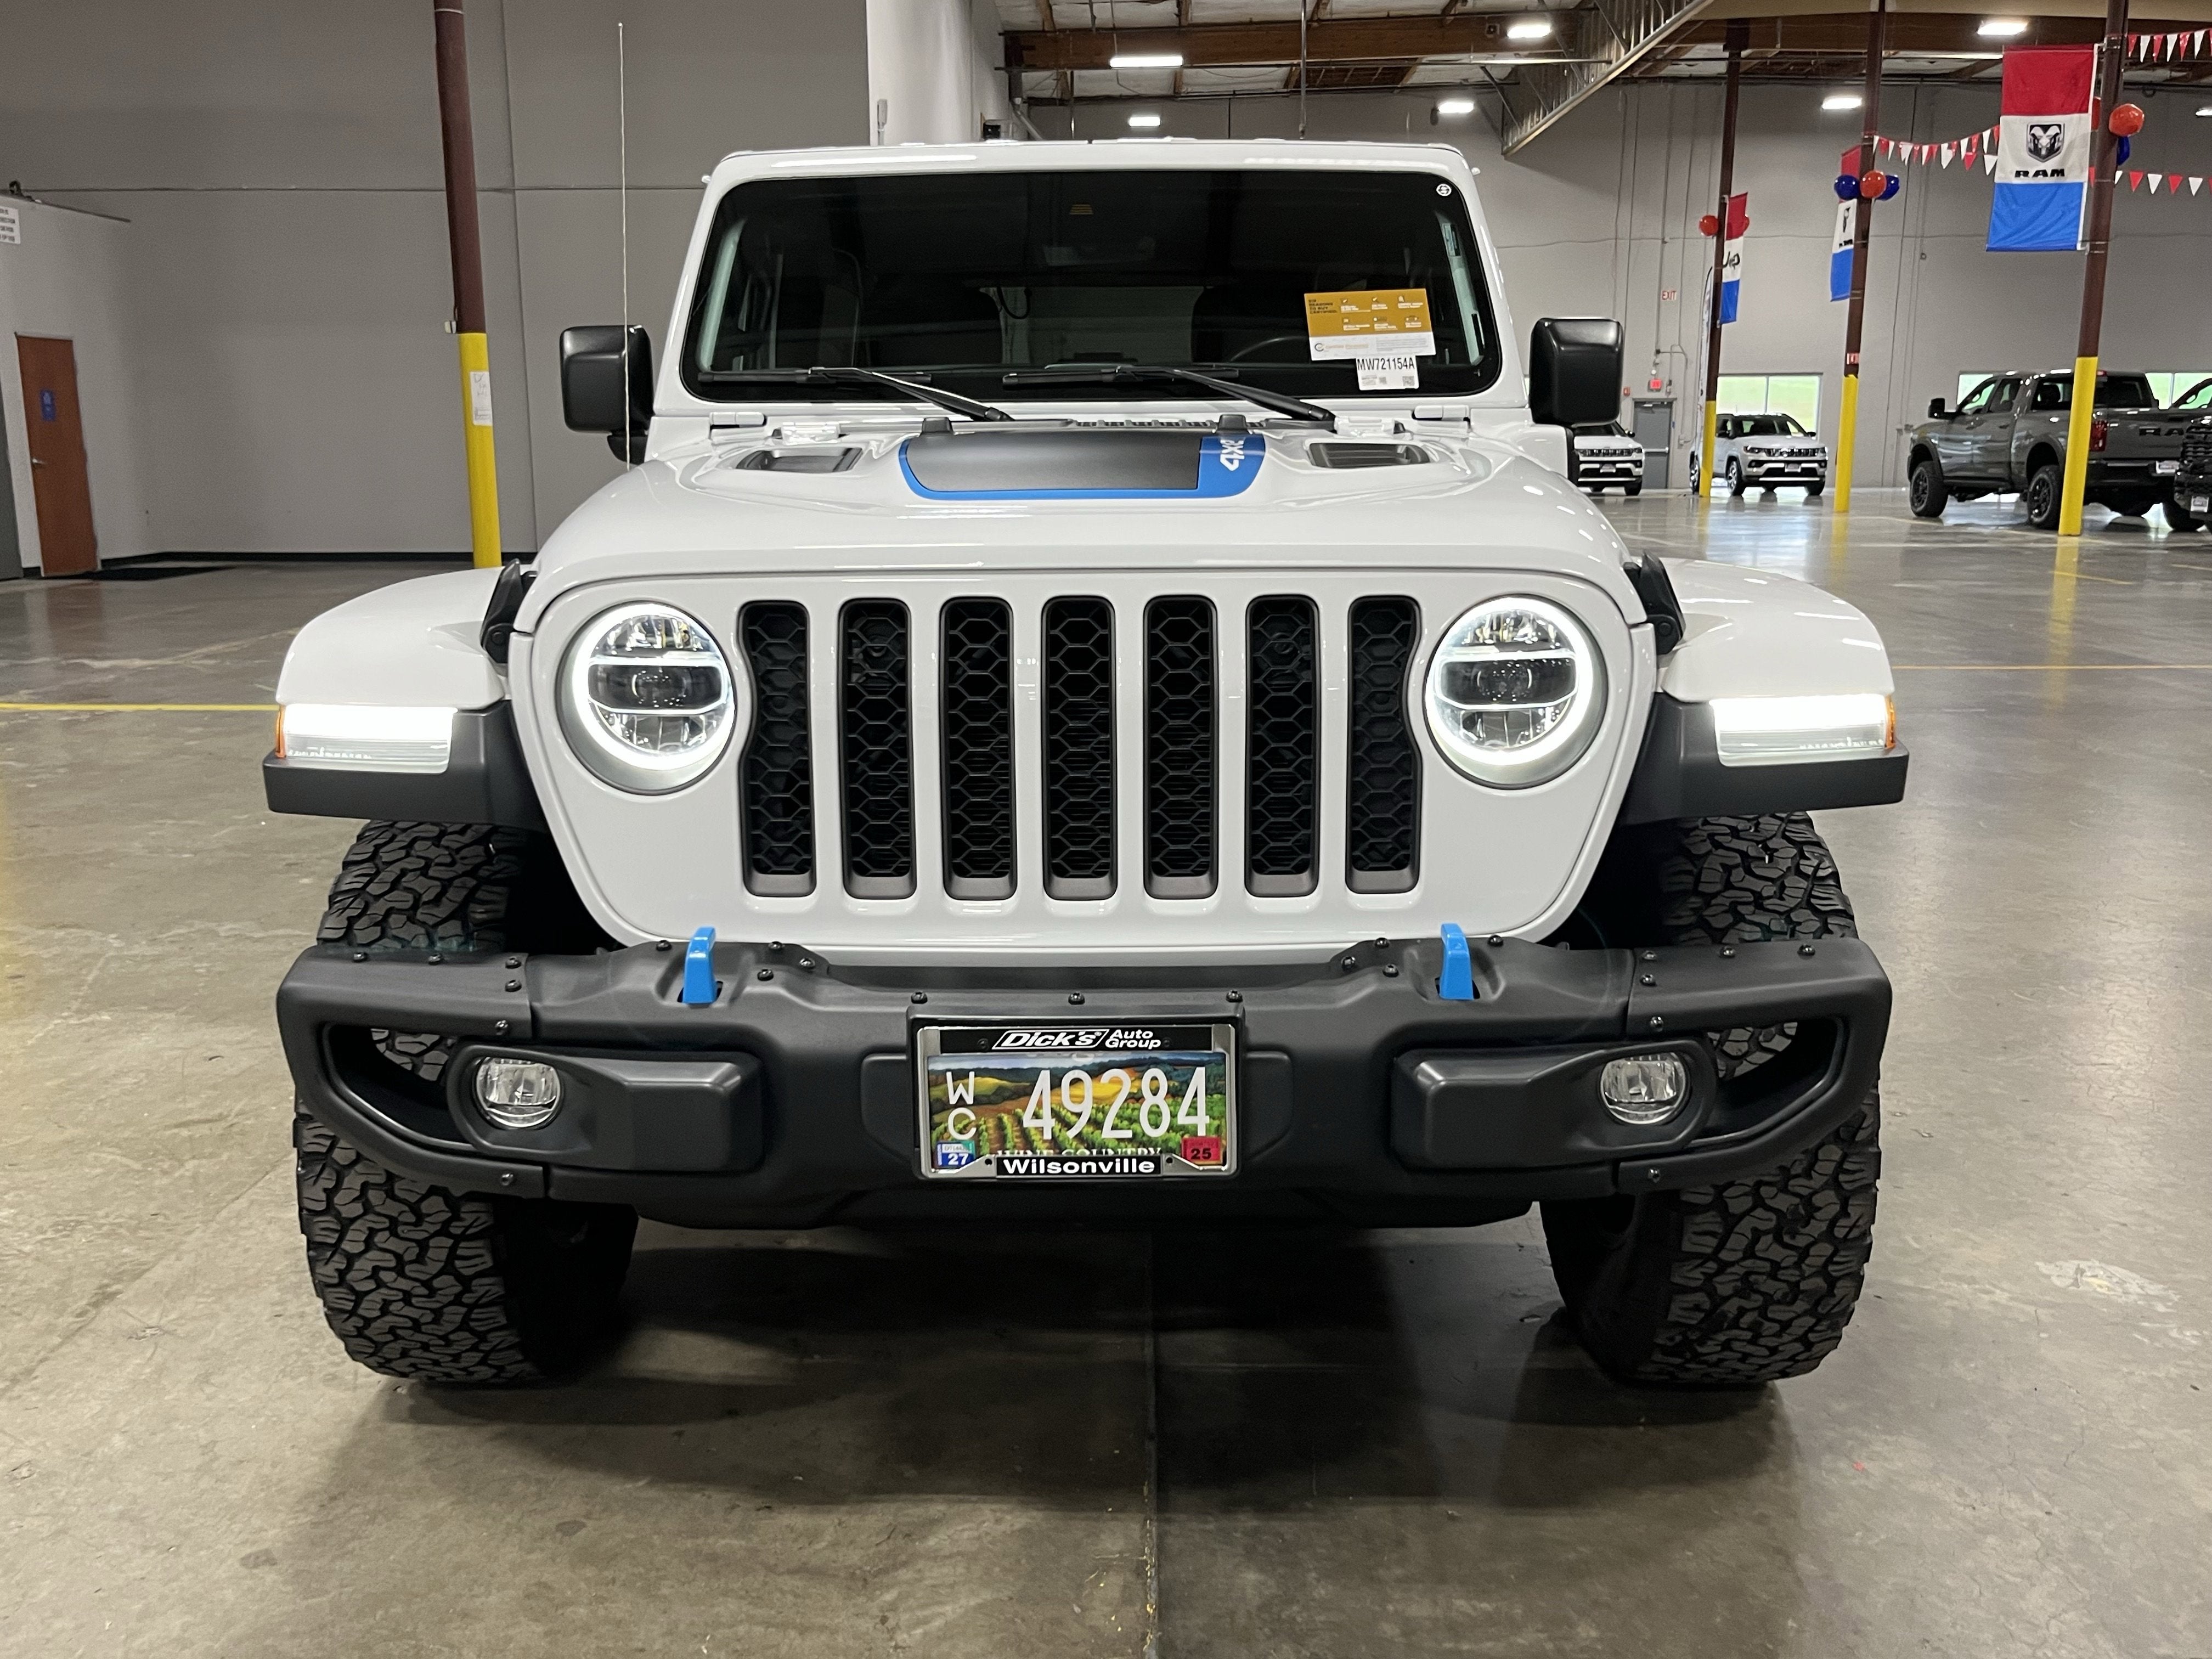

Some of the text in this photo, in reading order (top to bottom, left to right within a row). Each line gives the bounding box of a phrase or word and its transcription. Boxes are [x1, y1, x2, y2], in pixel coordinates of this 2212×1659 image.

[2015, 168, 2065, 178] RAM
[1662, 290, 1677, 300] EXIT
[1357, 358, 1415, 370] MW721154A
[1113, 1029, 1153, 1039] Auto
[1105, 1038, 1161, 1049] Group
[1023, 1066, 1210, 1139] 49284
[948, 1153, 969, 1165] 27
[1191, 1148, 1212, 1159] 25
[1003, 1158, 1155, 1174] Wilsonville
